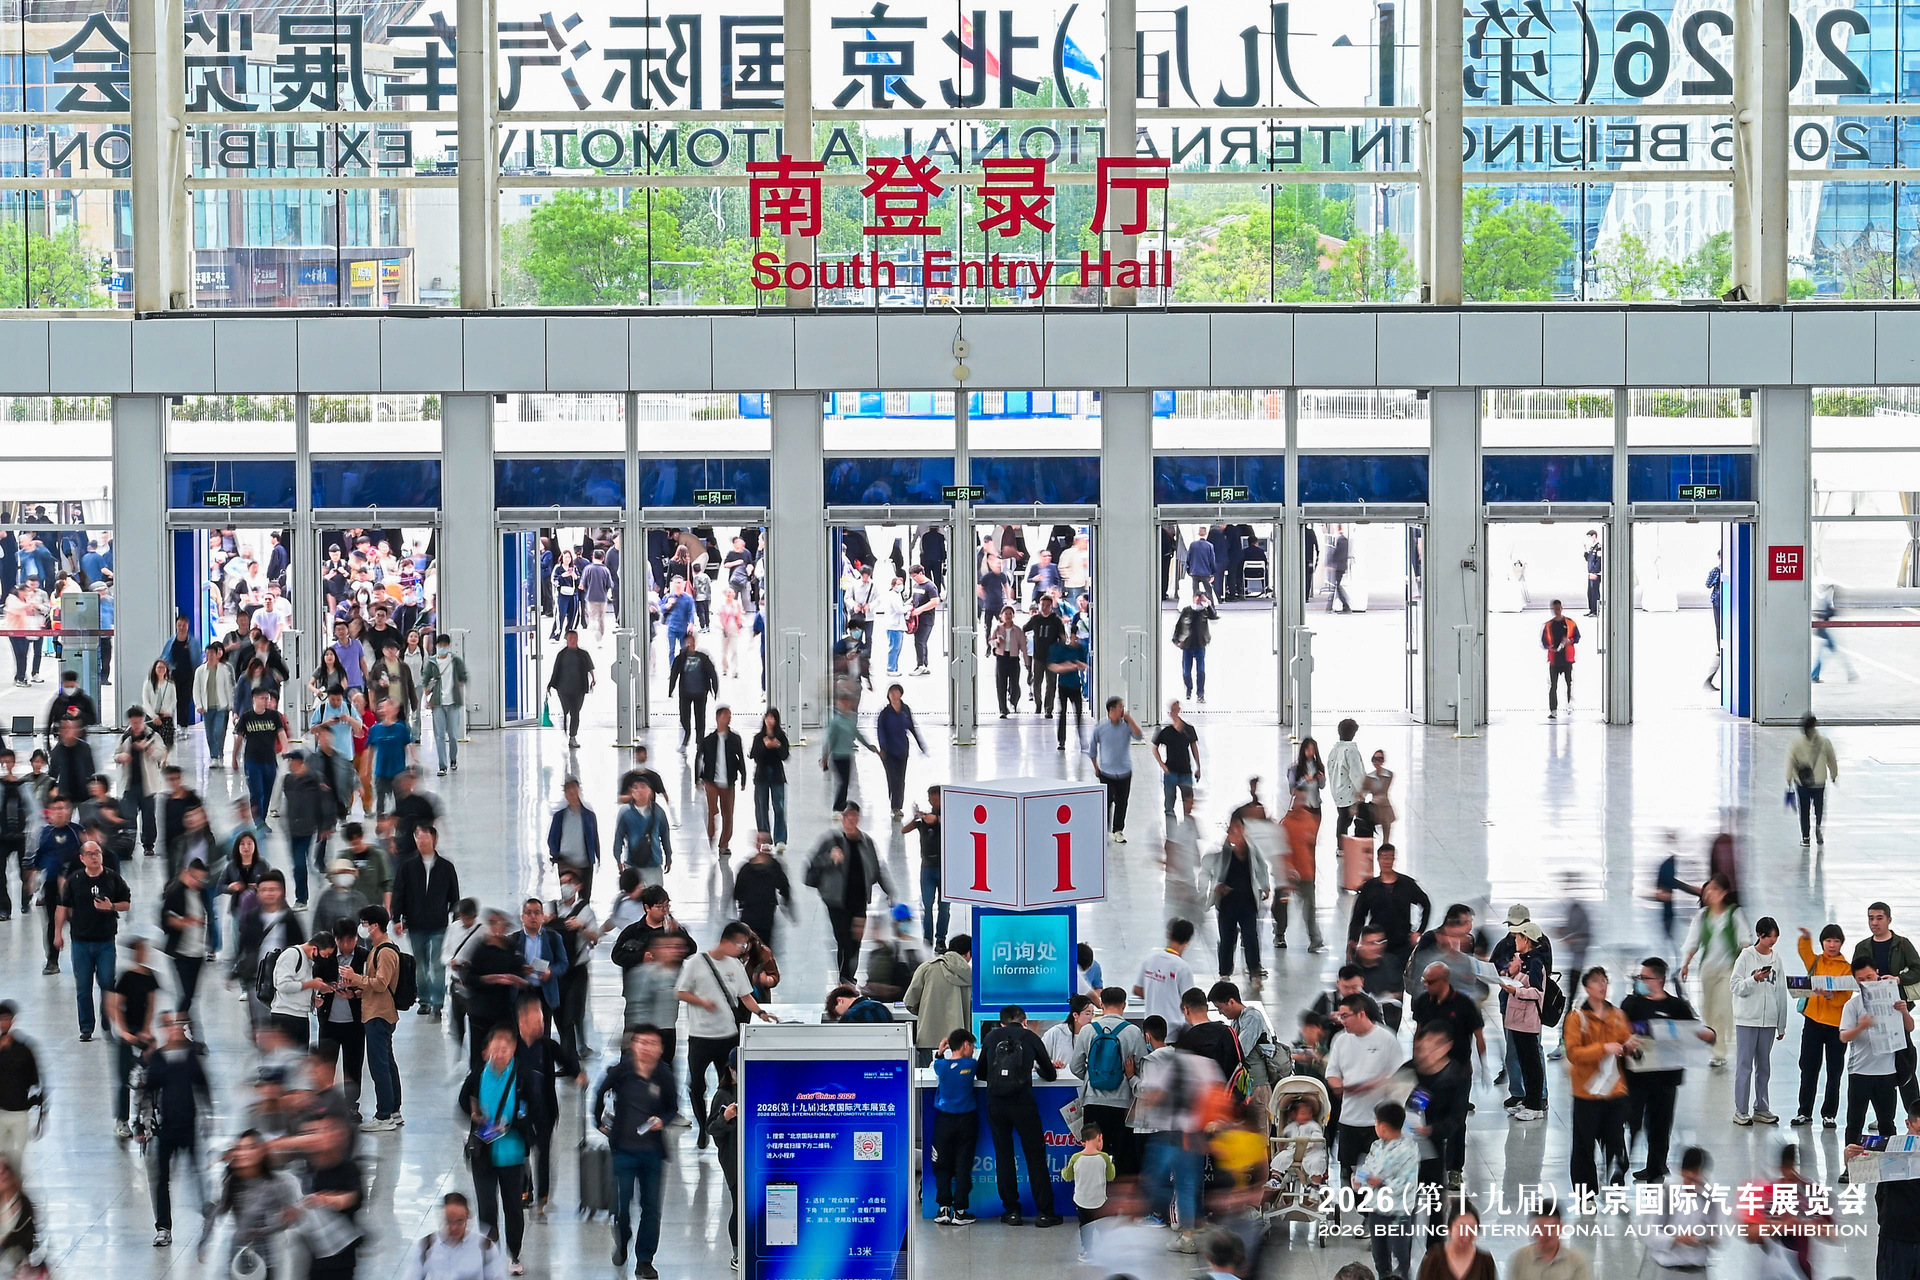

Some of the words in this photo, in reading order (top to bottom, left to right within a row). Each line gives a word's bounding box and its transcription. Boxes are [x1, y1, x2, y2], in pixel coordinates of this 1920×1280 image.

[746, 154, 1171, 238] 南登录厅
[750, 250, 896, 291] South
[923, 250, 1054, 299] Entry
[1080, 249, 1172, 289] Hall
[1775, 552, 1798, 564] 出口
[1776, 565, 1797, 573] EXIT
[970, 804, 992, 893] i
[1052, 804, 1076, 893] i
[992, 940, 1057, 961] 问询处
[992, 964, 1057, 975] Information
[796, 1092, 815, 1100] Auto
[815, 1091, 837, 1100] China
[837, 1092, 856, 1100] 2026
[848, 1246, 872, 1257] 1.3米
